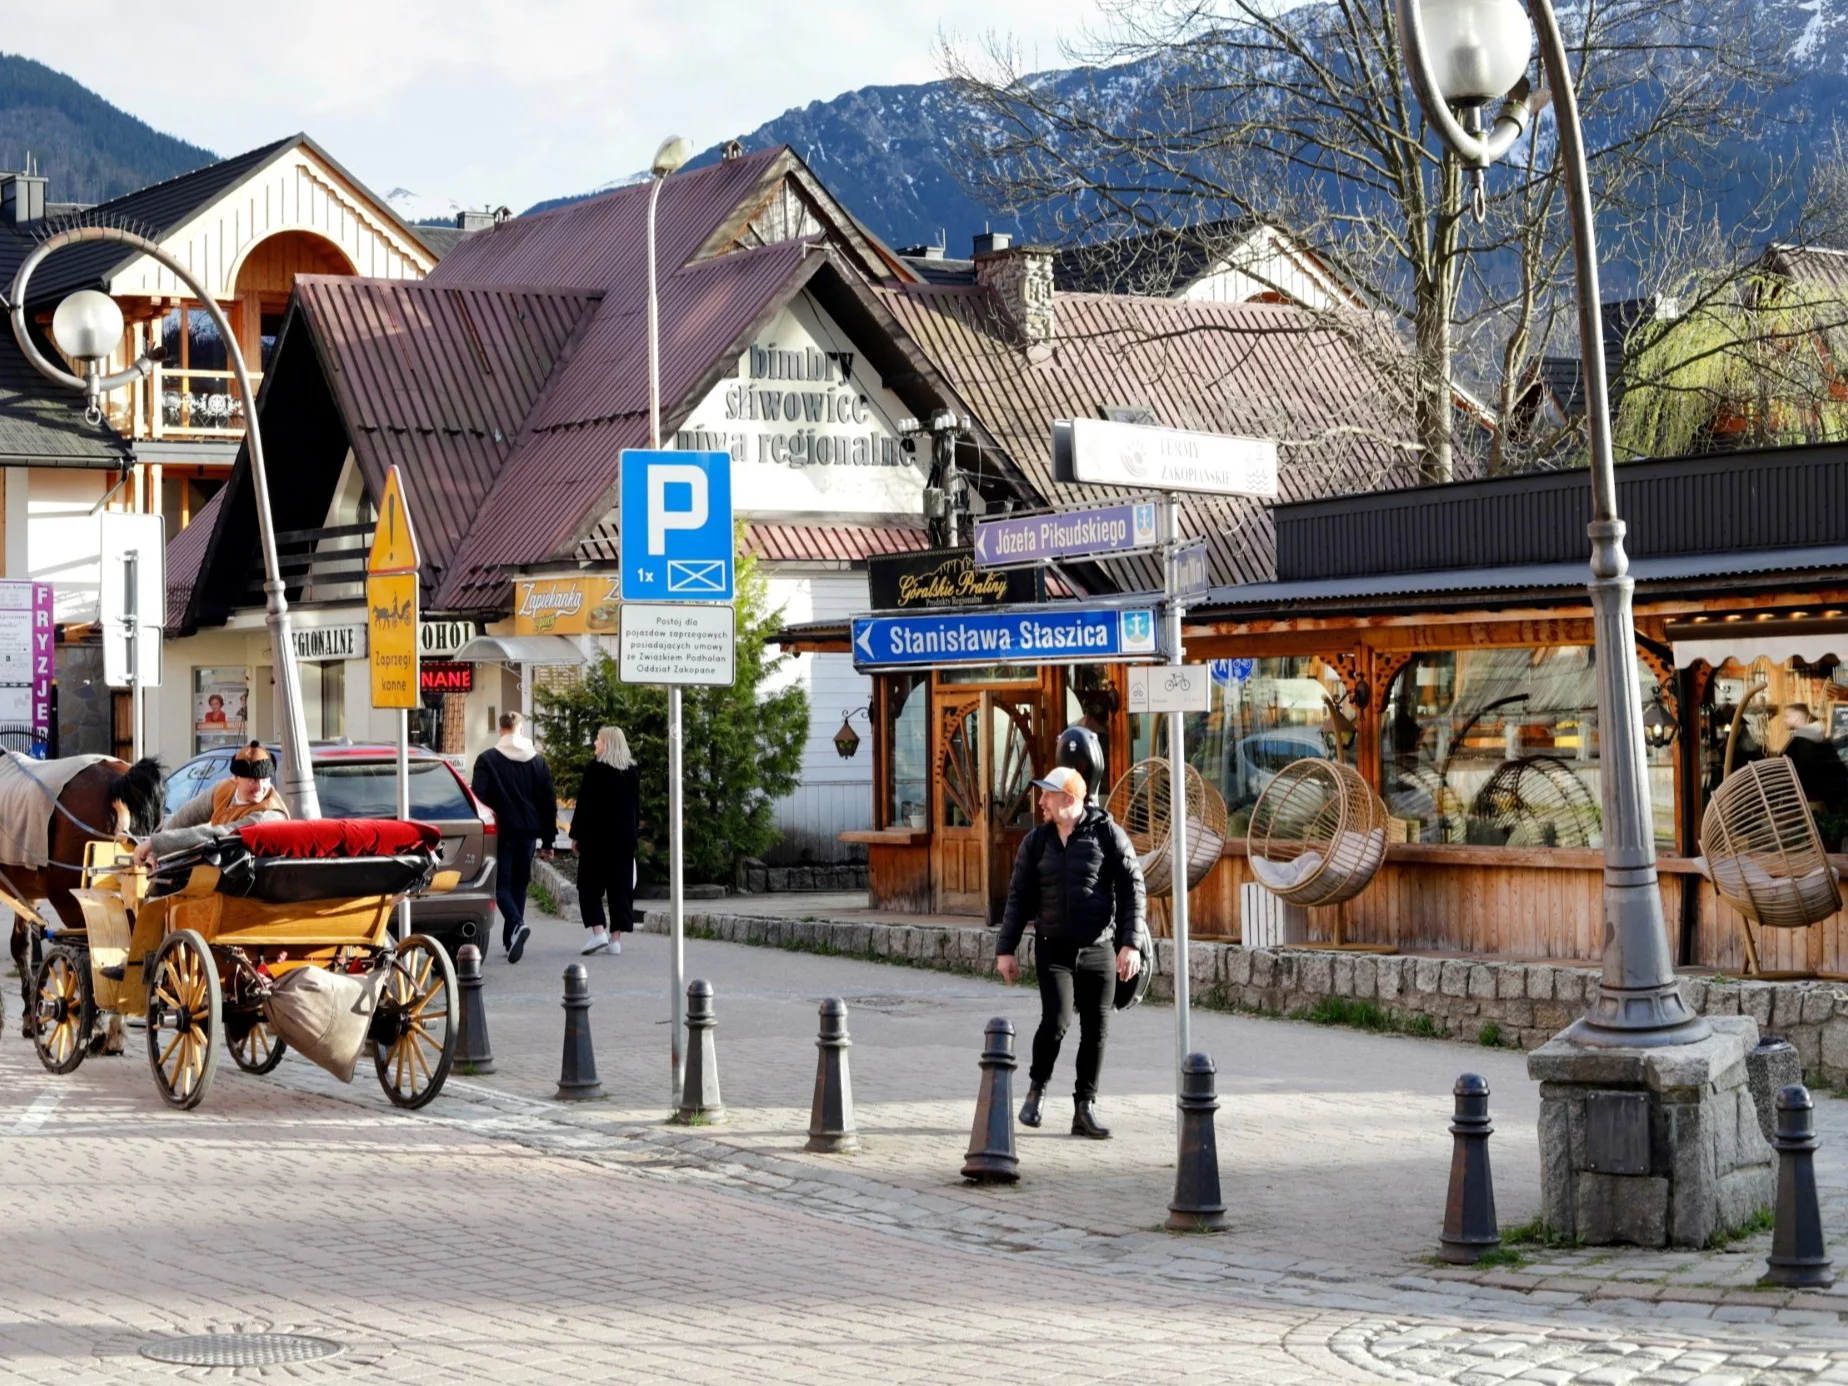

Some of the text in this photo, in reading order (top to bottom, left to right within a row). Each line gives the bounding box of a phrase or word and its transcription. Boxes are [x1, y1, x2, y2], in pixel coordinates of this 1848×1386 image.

[750, 343, 854, 387] bimbry
[758, 428, 916, 469] regionalne
[647, 464, 708, 556] P
[995, 516, 1126, 555] Józefa Piłsudskiego
[637, 567, 654, 582] 1x
[604, 579, 619, 600] Z
[898, 570, 1007, 607] Góralskie Praliny
[685, 618, 698, 626] dla
[291, 628, 354, 657] EGIONALNE
[694, 643, 723, 652] umowy
[890, 619, 1108, 655] Stanisława Staszica
[627, 653, 636, 661] ze
[686, 653, 726, 663] Podhalan
[636, 664, 716, 675] Oddział Zakopane
[381, 677, 407, 692] konne
